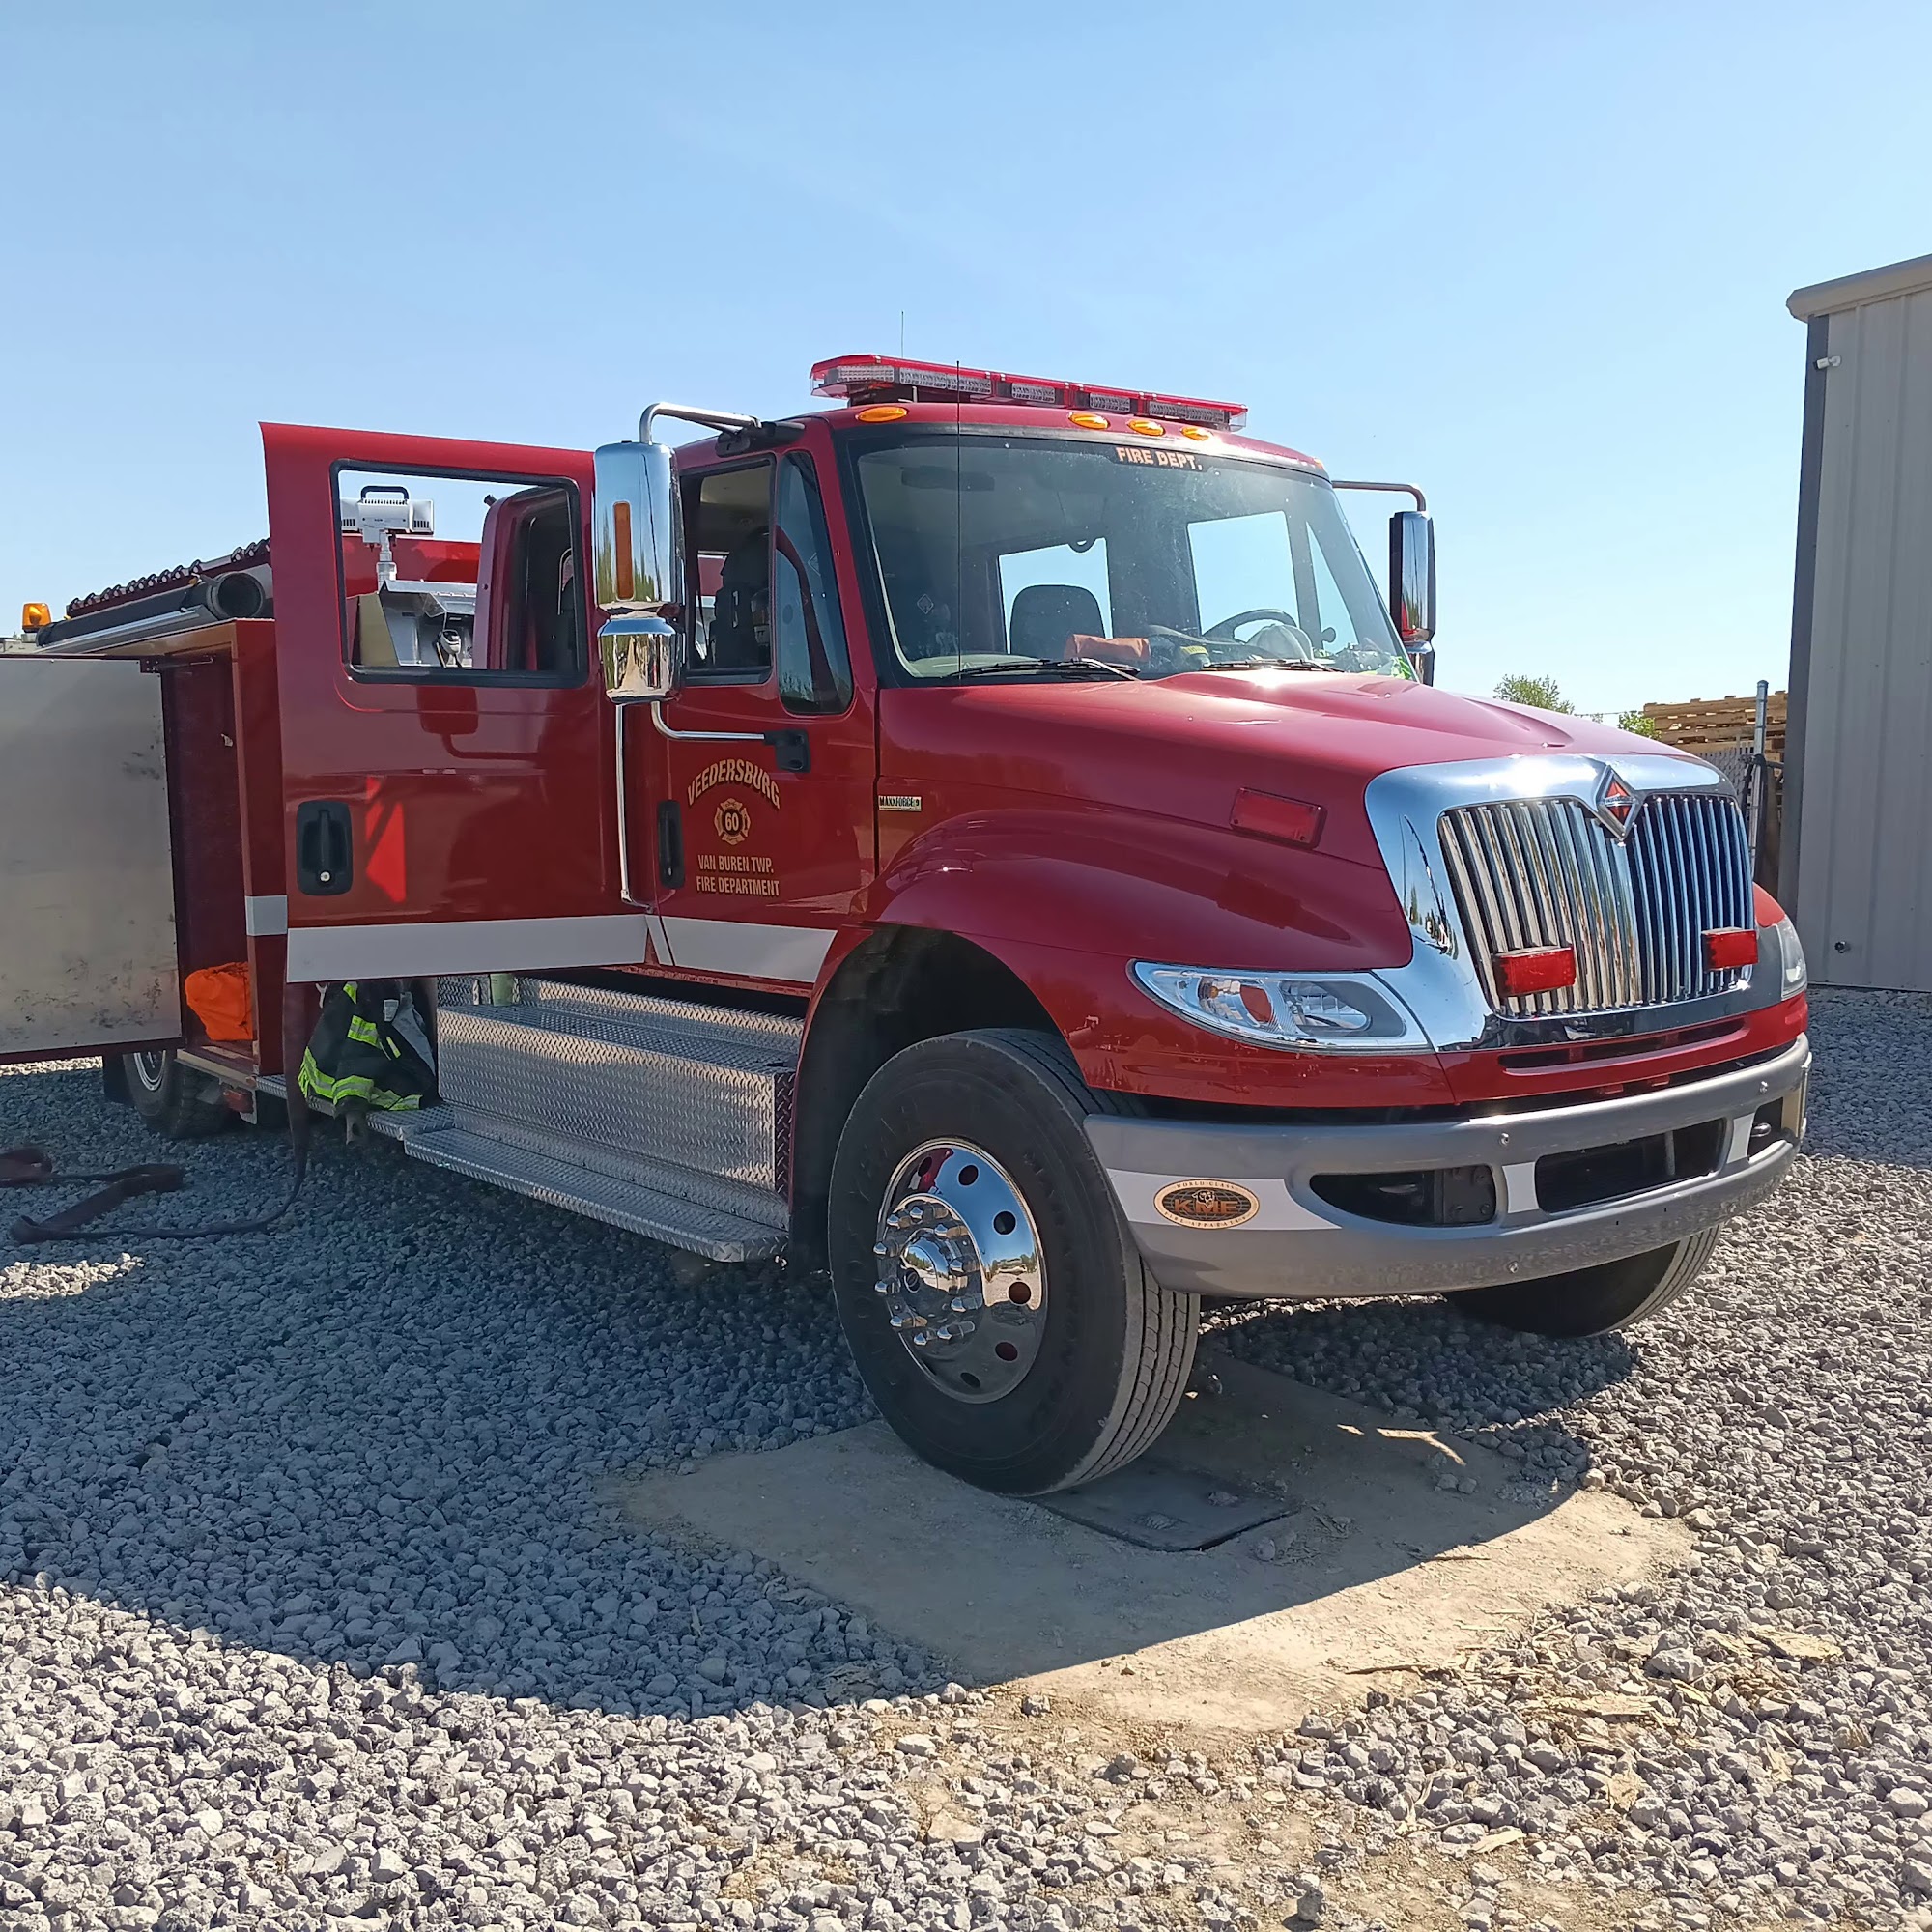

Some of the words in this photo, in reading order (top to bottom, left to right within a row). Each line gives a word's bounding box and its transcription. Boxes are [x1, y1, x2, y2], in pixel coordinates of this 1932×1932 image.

[1116, 447, 1154, 464] FIRE
[1156, 451, 1203, 470] DEPT.
[687, 758, 781, 810] VEEDERSBURG
[724, 812, 739, 832] 60
[697, 854, 717, 870] VAN
[718, 855, 750, 872] BUREN
[751, 856, 775, 874] TWP.
[696, 875, 717, 892] FIRE
[718, 876, 780, 896] DEPARTMENT
[1174, 1199, 1238, 1215] KME
